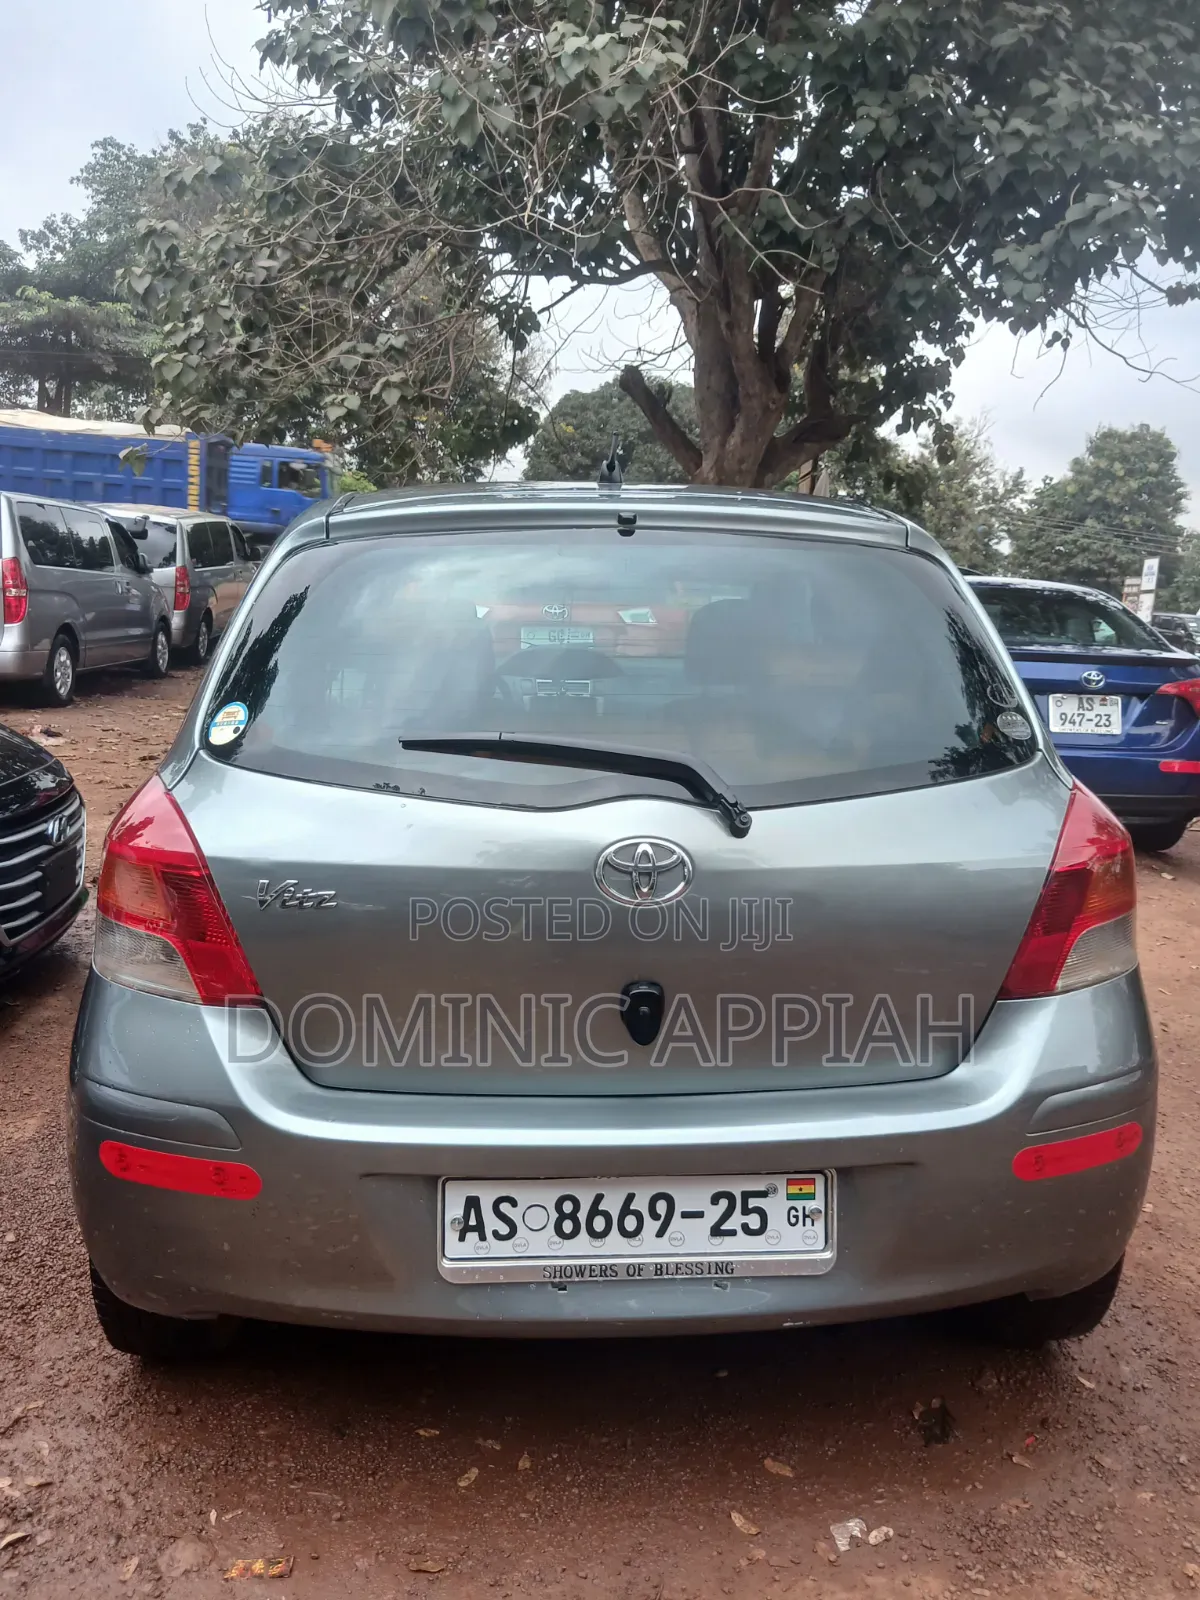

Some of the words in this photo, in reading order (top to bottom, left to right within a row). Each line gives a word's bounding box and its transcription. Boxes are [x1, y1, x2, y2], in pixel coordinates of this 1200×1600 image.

[1077, 696, 1095, 711] AS
[1060, 712, 1112, 728] 947-23
[257, 879, 338, 911] Vitz
[458, 1195, 518, 1242] AS
[553, 1191, 769, 1240] 8669-25
[787, 1205, 815, 1227] GH
[542, 1264, 619, 1279] SHOWERS
[625, 1263, 646, 1278] OF
[653, 1261, 735, 1277] BLESSING
